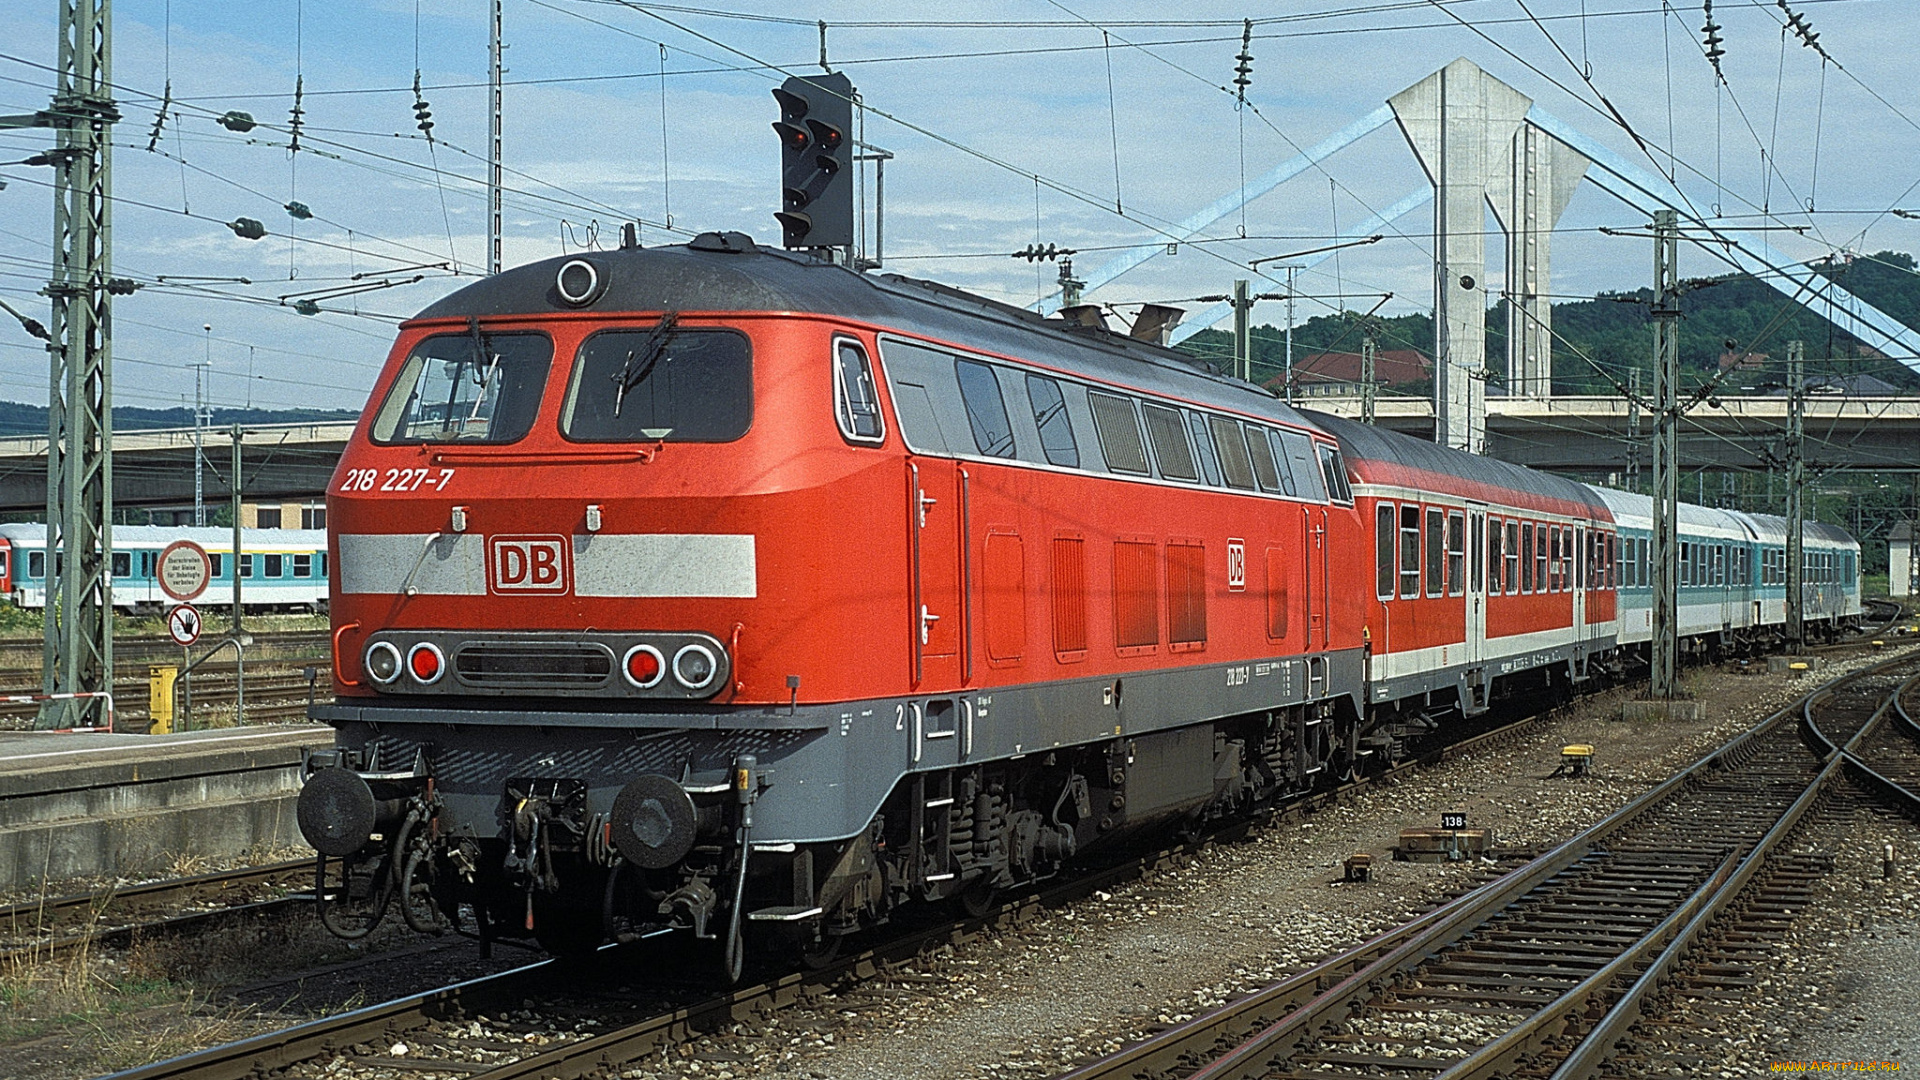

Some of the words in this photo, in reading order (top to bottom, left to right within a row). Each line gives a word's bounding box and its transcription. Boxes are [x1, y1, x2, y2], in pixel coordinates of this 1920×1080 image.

[340, 469, 377, 491] 218
[381, 469, 454, 491] 227-7
[285, 556, 290, 566] 1
[499, 545, 558, 585] DB
[1229, 547, 1243, 582] DB
[896, 704, 903, 731] 2
[1445, 816, 1463, 827] 138
